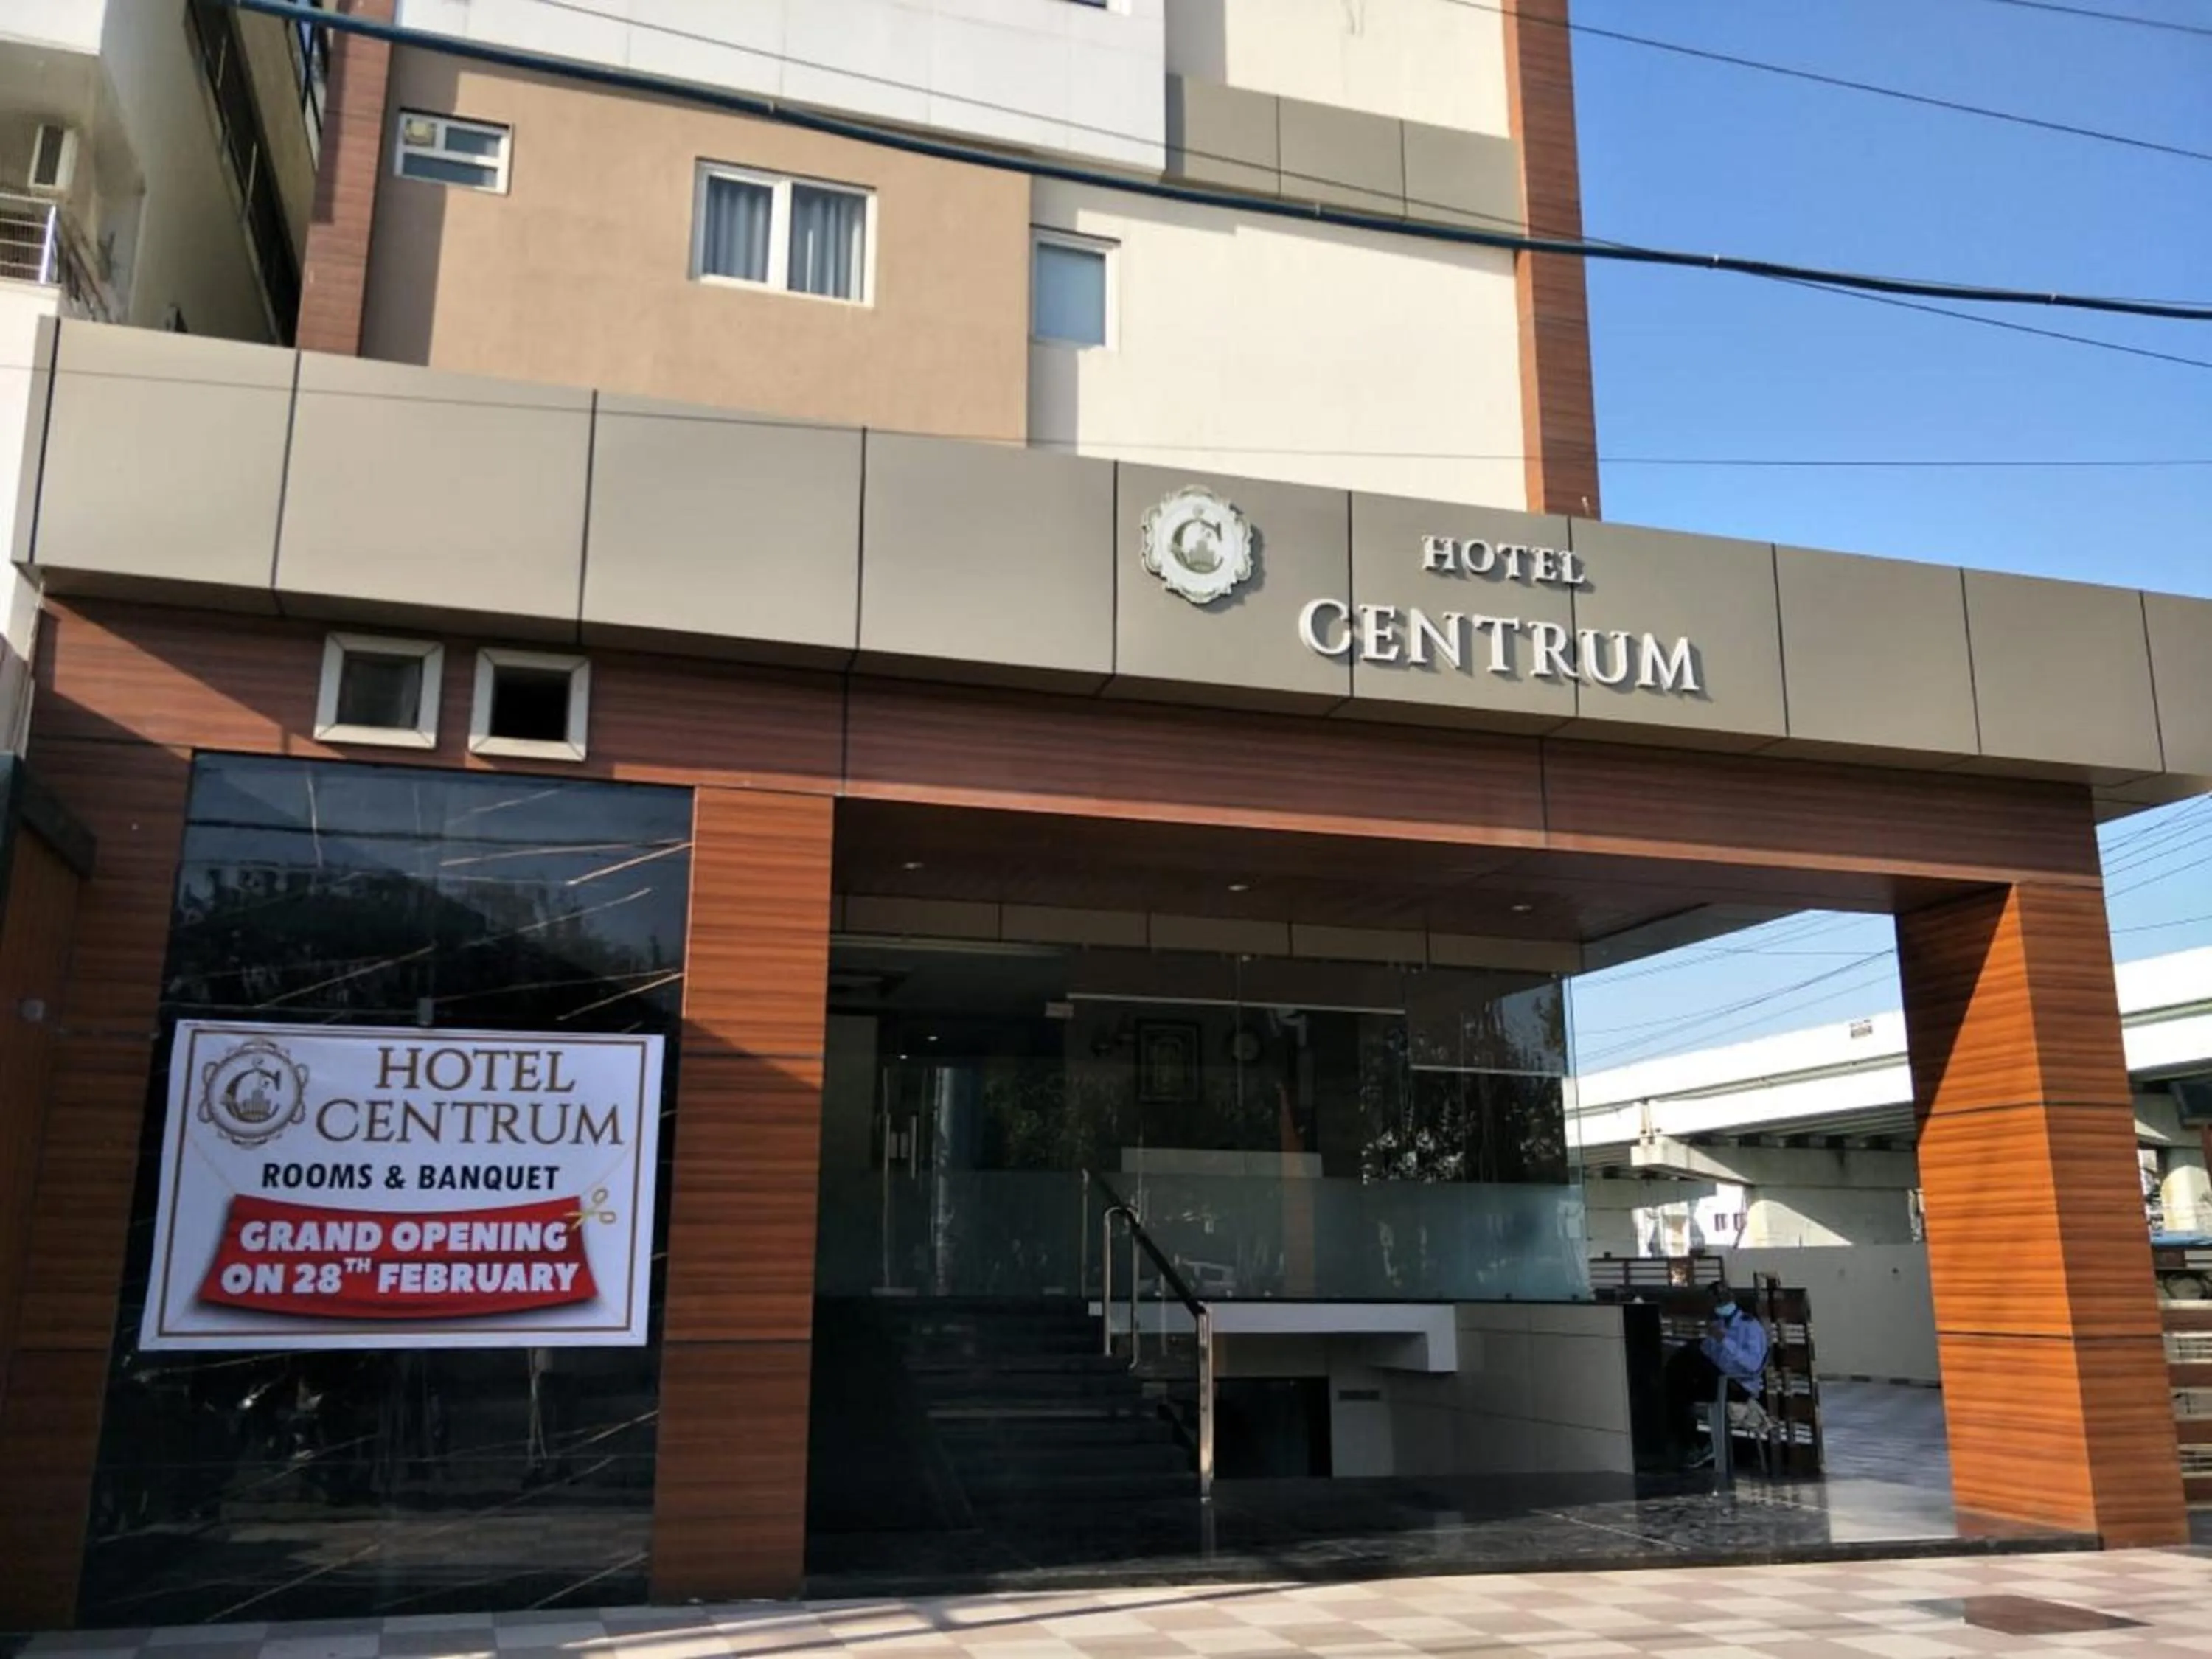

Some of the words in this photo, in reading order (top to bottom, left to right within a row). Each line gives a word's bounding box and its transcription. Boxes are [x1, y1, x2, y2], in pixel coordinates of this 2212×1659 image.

[1422, 534, 1585, 585] HOTEL
[1298, 598, 1700, 692] CENTRUM
[374, 1046, 576, 1093] HOTEL
[316, 1099, 625, 1145] CENTRUM
[262, 1163, 373, 1190] ROOMS
[384, 1164, 407, 1189] &
[418, 1164, 560, 1190] BANQUET
[240, 1221, 381, 1251] GRAND
[391, 1221, 568, 1251] OPENING
[221, 1263, 284, 1293] ON
[377, 1262, 580, 1293] FEBRUARY
